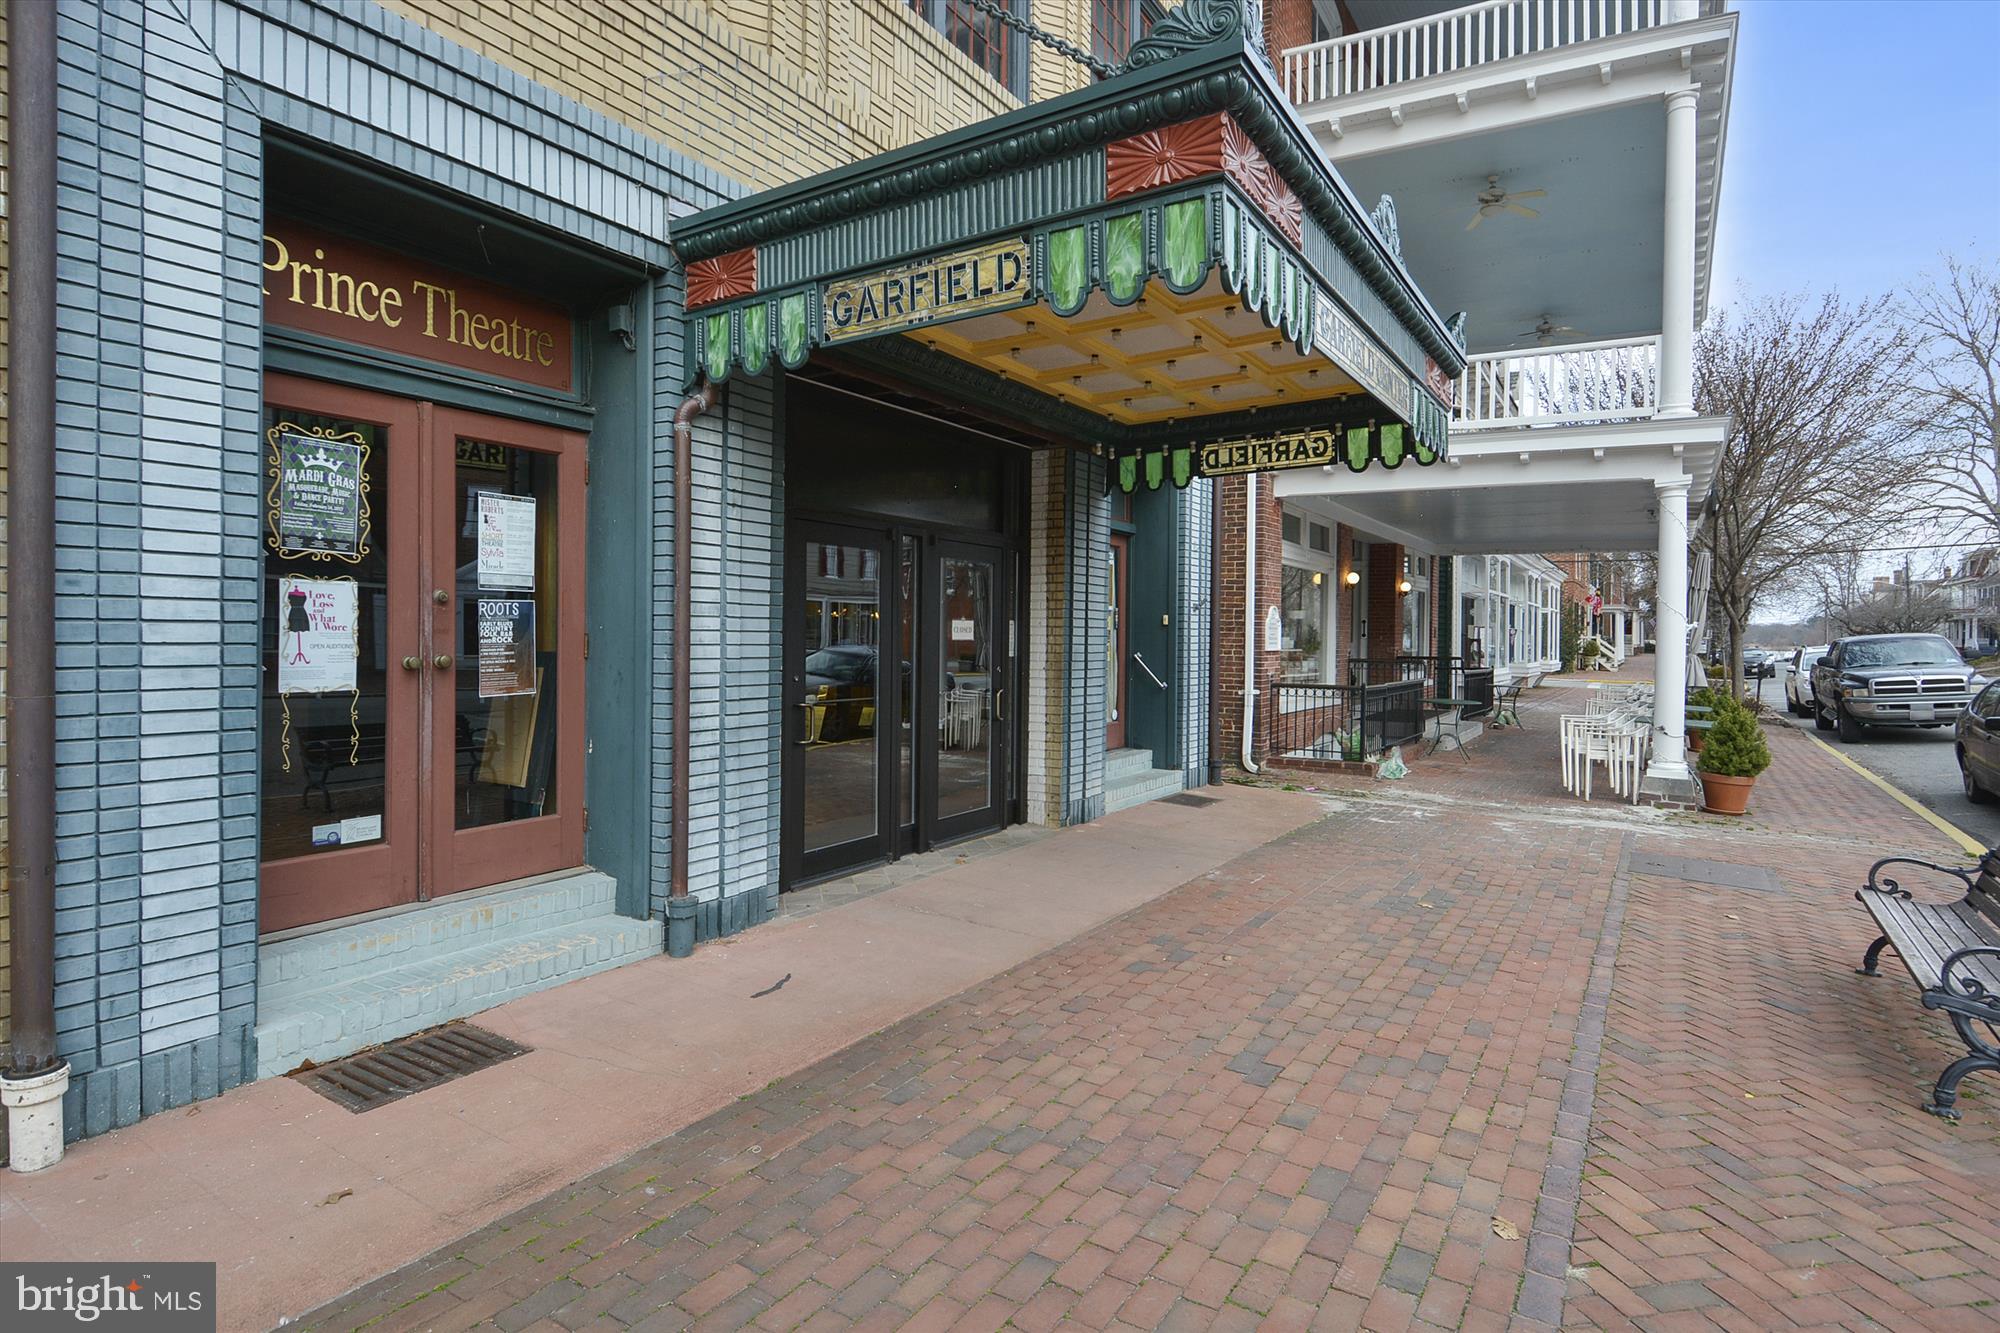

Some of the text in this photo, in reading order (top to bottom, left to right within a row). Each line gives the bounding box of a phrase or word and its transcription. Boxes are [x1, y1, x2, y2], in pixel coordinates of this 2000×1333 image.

[832, 250, 1023, 328] GARFIELD
[263, 234, 554, 367] Prince Theatre
[284, 468, 355, 490] MARDI GRAS
[293, 491, 300, 499] &
[301, 492, 321, 502] DANCE
[308, 590, 335, 600] Love,
[312, 599, 334, 608] Loss
[479, 602, 520, 619] ROOTS
[309, 613, 336, 622] What
[314, 622, 348, 631] I Wore
